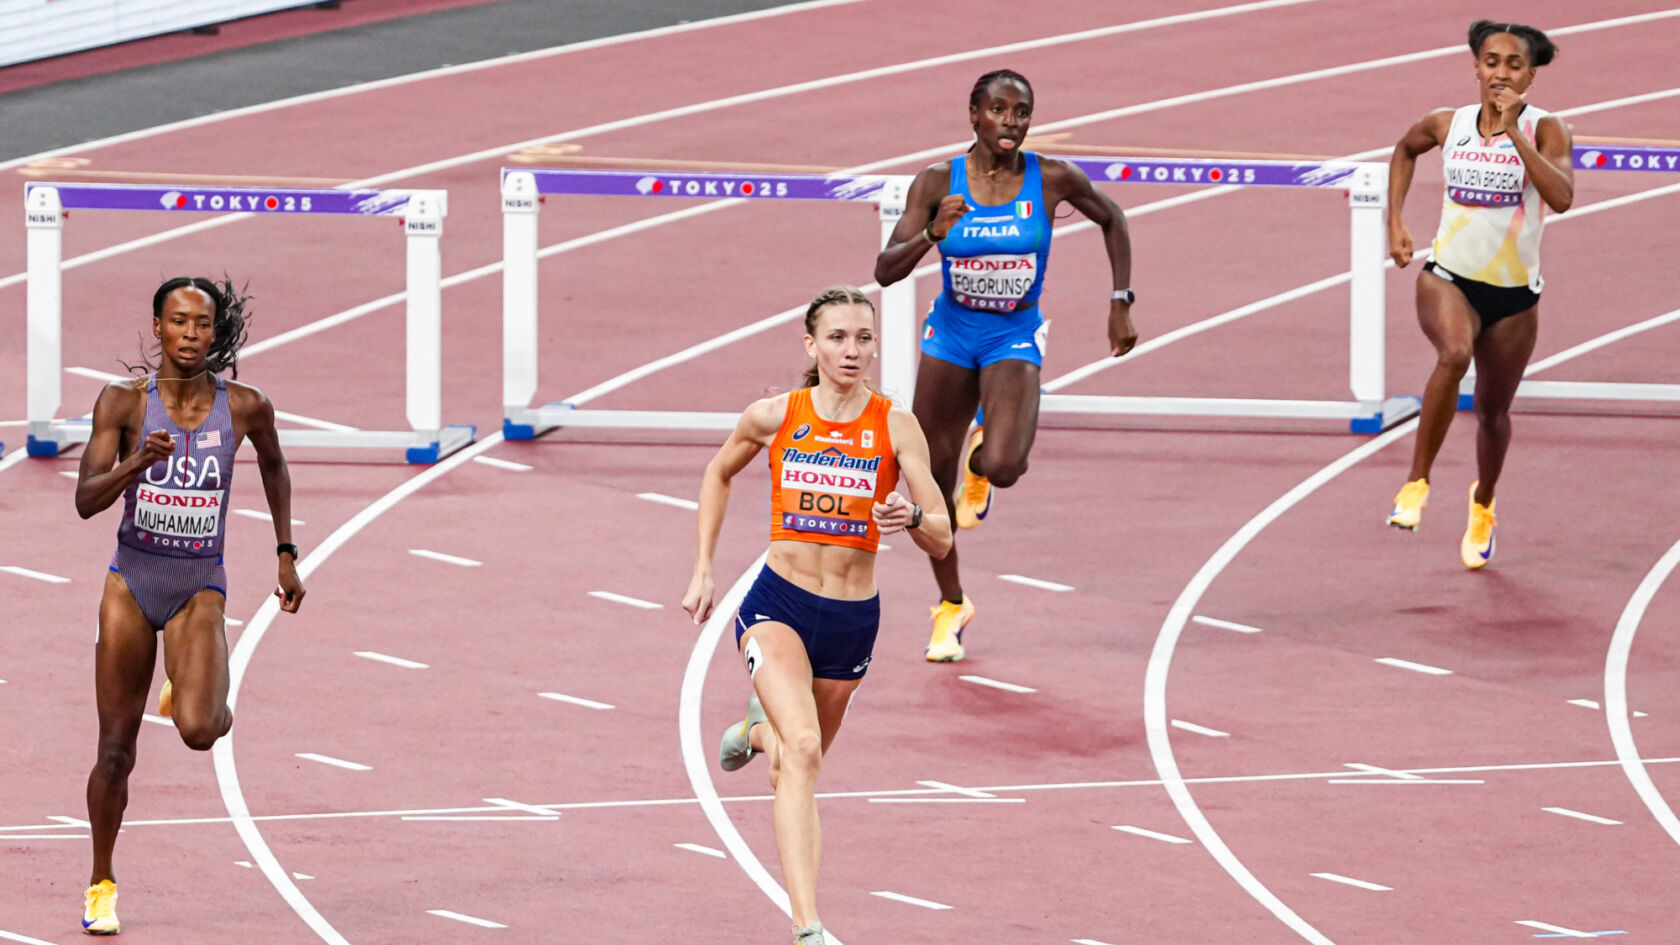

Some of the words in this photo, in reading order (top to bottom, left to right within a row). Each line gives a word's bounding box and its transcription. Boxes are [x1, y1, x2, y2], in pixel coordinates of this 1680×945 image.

[1451, 151, 1521, 166] HONDA
[1612, 154, 1678, 169] TOKY
[1138, 167, 1255, 182] TOKYO25
[1464, 169, 1482, 185] DEN
[1483, 171, 1520, 190] BROECK
[669, 180, 788, 196] TOKYO25
[193, 195, 312, 211] TOKYO25
[1353, 194, 1380, 202] NISHI
[28, 214, 56, 223] NISHI
[883, 208, 904, 216] NIS
[408, 221, 436, 230] NISHI
[963, 225, 1020, 238] ITALIA
[955, 259, 1034, 270] HONDA
[954, 275, 1033, 295] FOLORUNSO
[971, 299, 1016, 309] TOKYO
[145, 455, 221, 489] USA
[784, 470, 872, 491] HONDA
[139, 488, 219, 508] HONDA
[799, 491, 850, 516] BOL
[137, 507, 216, 535] MUHAMMAD
